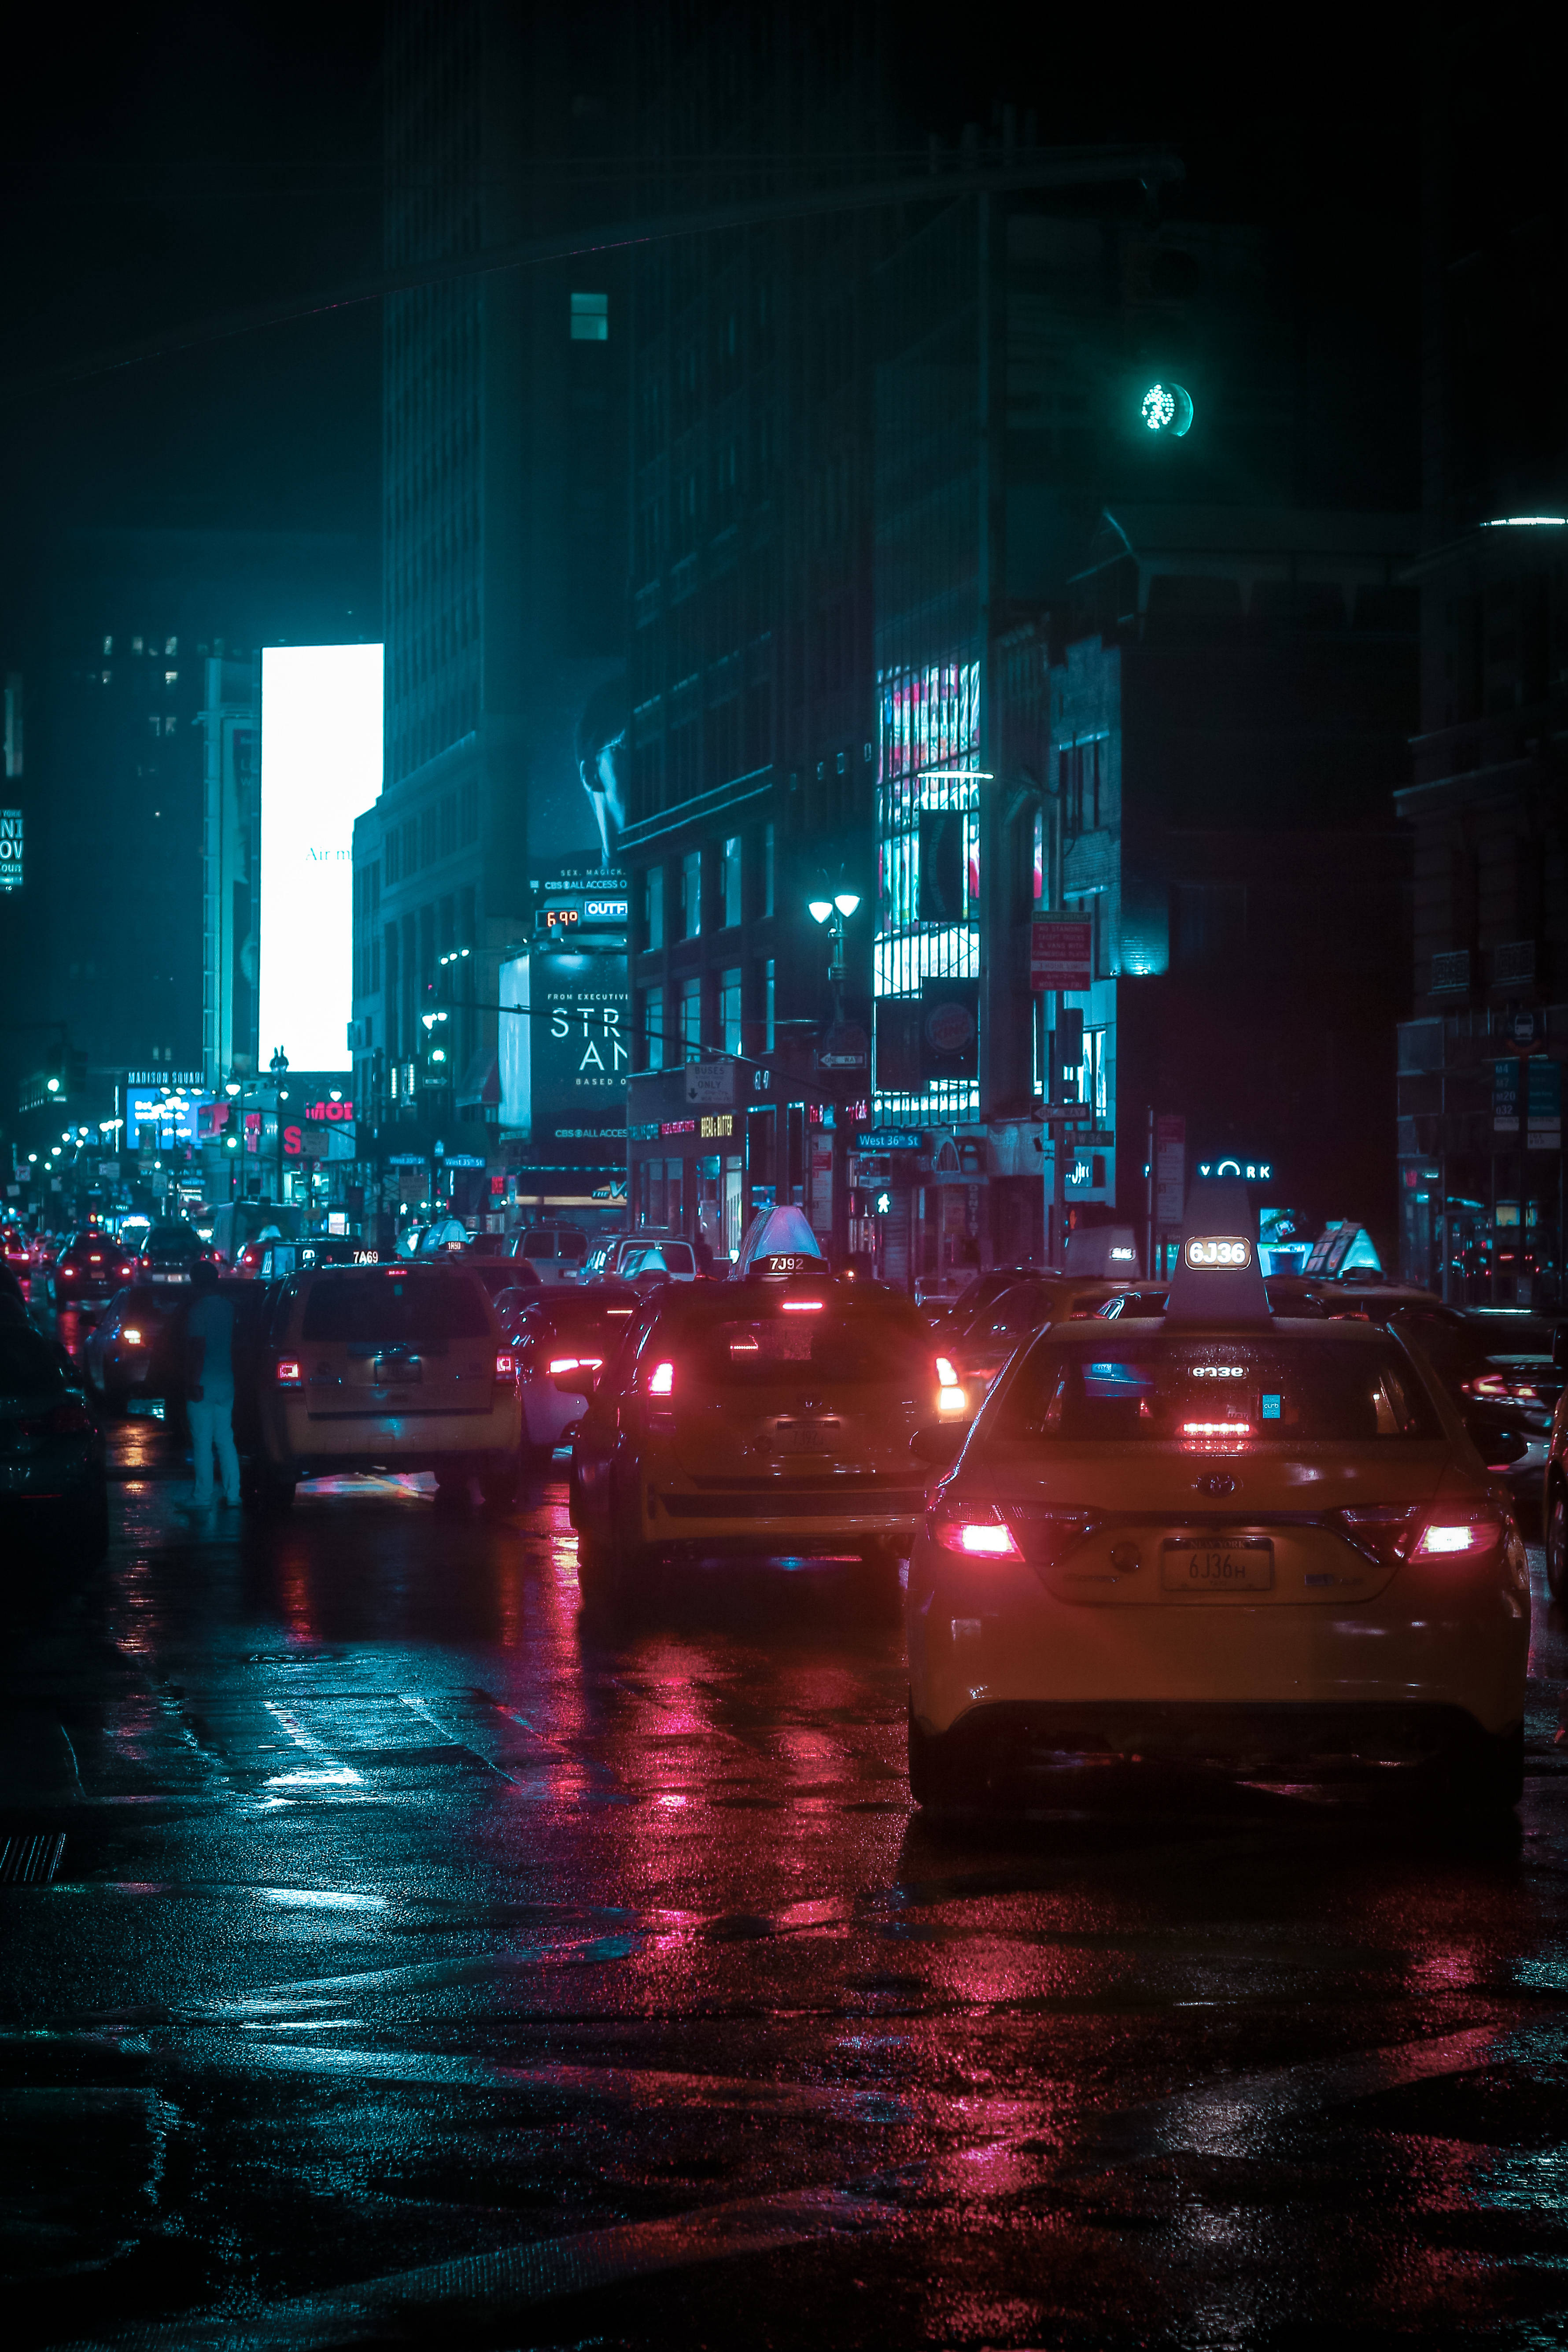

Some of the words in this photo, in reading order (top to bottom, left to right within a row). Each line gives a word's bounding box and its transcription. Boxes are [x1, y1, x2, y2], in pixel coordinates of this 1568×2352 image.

[306, 846, 330, 860] Air
[586, 880, 617, 889] ACCESS
[588, 903, 627, 914] OUTF
[550, 1007, 620, 1038] STR
[695, 1066, 725, 1074] BUSES
[128, 1072, 168, 1084] MADISON
[698, 1080, 721, 1089] ONLY
[1496, 1091, 1516, 1101] M20
[284, 1126, 302, 1155] S
[860, 1135, 885, 1145] West
[908, 1135, 918, 1146] St
[354, 1251, 378, 1265] 7A69
[1190, 1242, 1246, 1263] 6J36
[770, 1258, 804, 1270] 7J92
